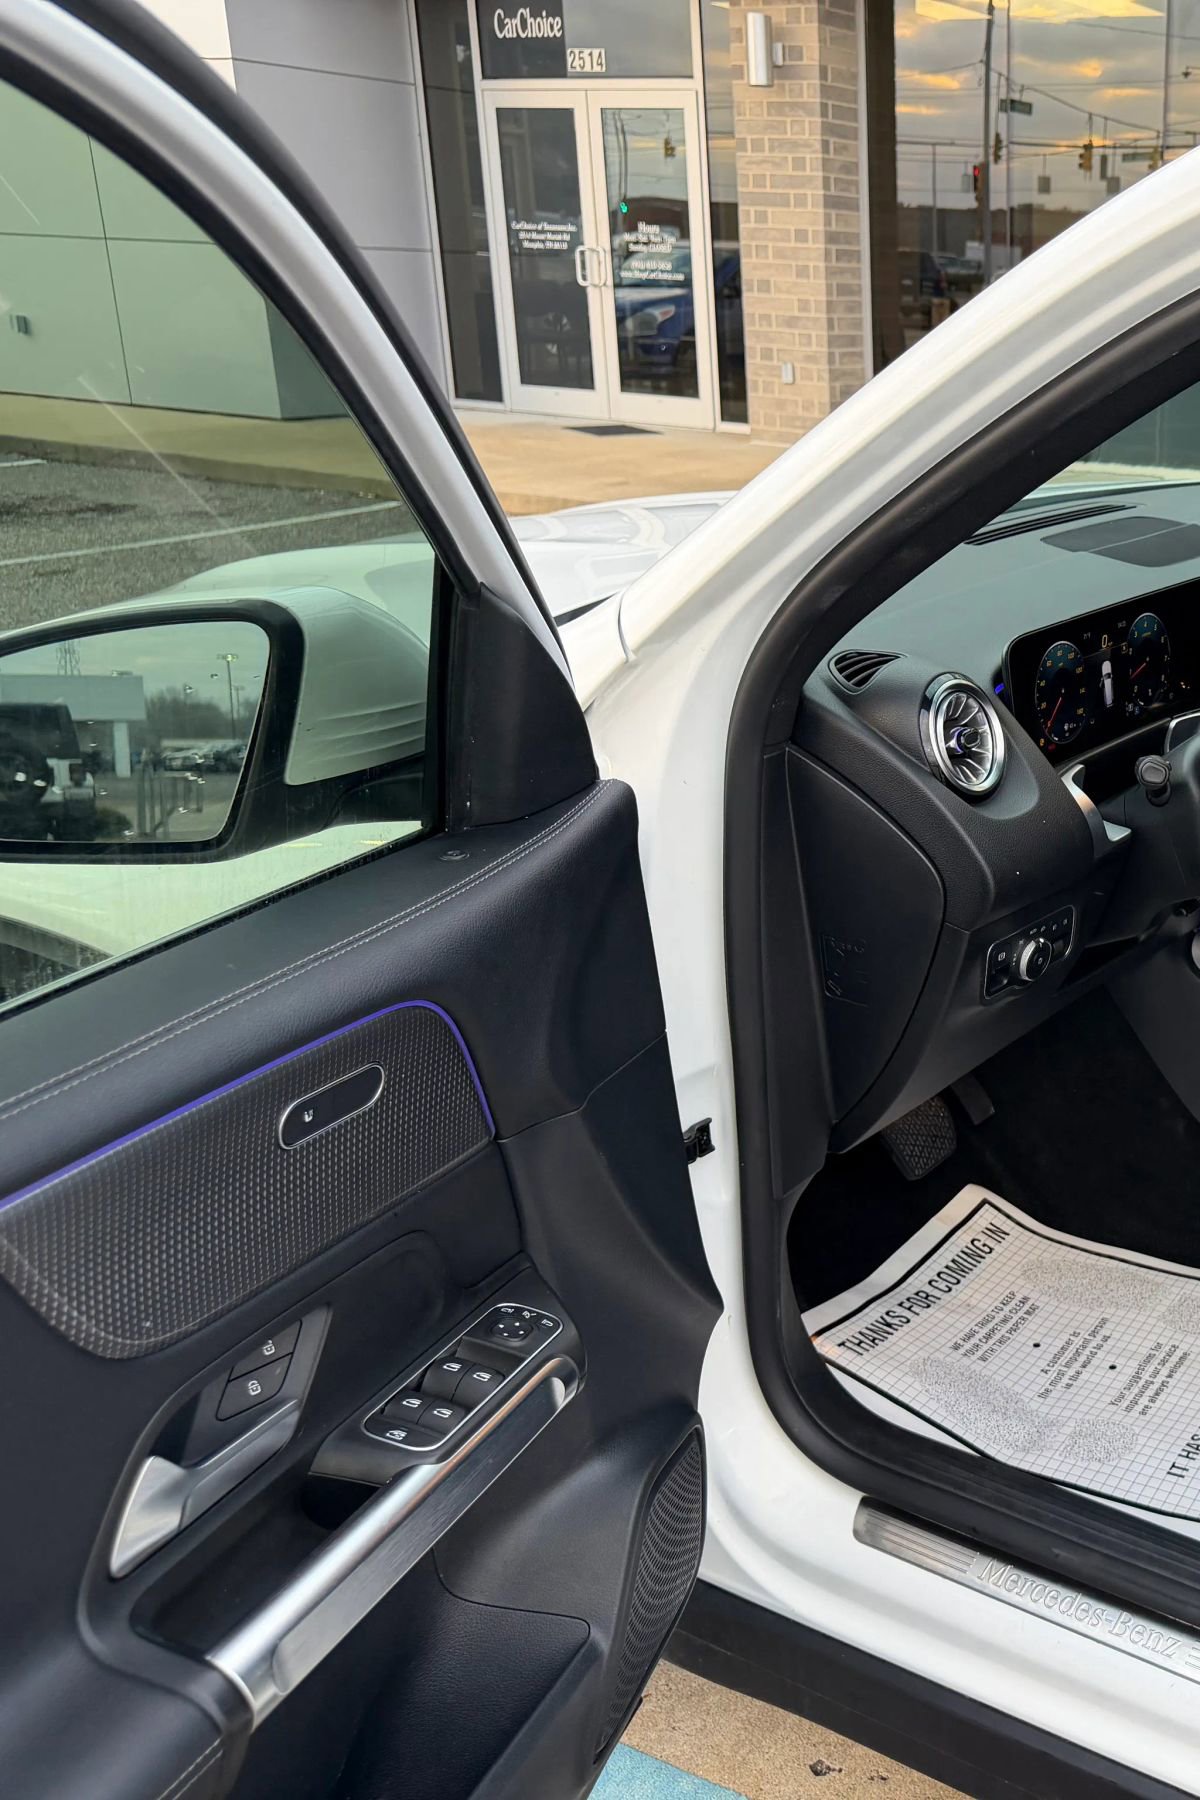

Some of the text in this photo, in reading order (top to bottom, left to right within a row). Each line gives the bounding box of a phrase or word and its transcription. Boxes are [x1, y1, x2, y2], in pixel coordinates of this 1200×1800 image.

[494, 7, 562, 38] CarChoice
[569, 50, 604, 71] 2514
[837, 1222, 1011, 1356] THANKS FOR COMING IN
[949, 1290, 1017, 1351] WE HAVE TRIED TO KEEP
[961, 1295, 1031, 1357] YOUR CARPETING CLEAN
[977, 1302, 1040, 1362] WITH THIS PAPER MAT
[1037, 1317, 1110, 1400] the most important person
[1047, 1338, 1075, 1368] customer
[1068, 1369, 1083, 1382] the
[1080, 1350, 1098, 1369] world
[1092, 1342, 1104, 1351] to
[1108, 1341, 1163, 1407] Your suggestions for
[1120, 1343, 1179, 1413] improving our service
[1139, 1404, 1152, 1416] are
[1148, 1380, 1170, 1404] always
[1166, 1461, 1189, 1479] IT
[976, 1558, 1183, 1659] Mercedes-Benz
